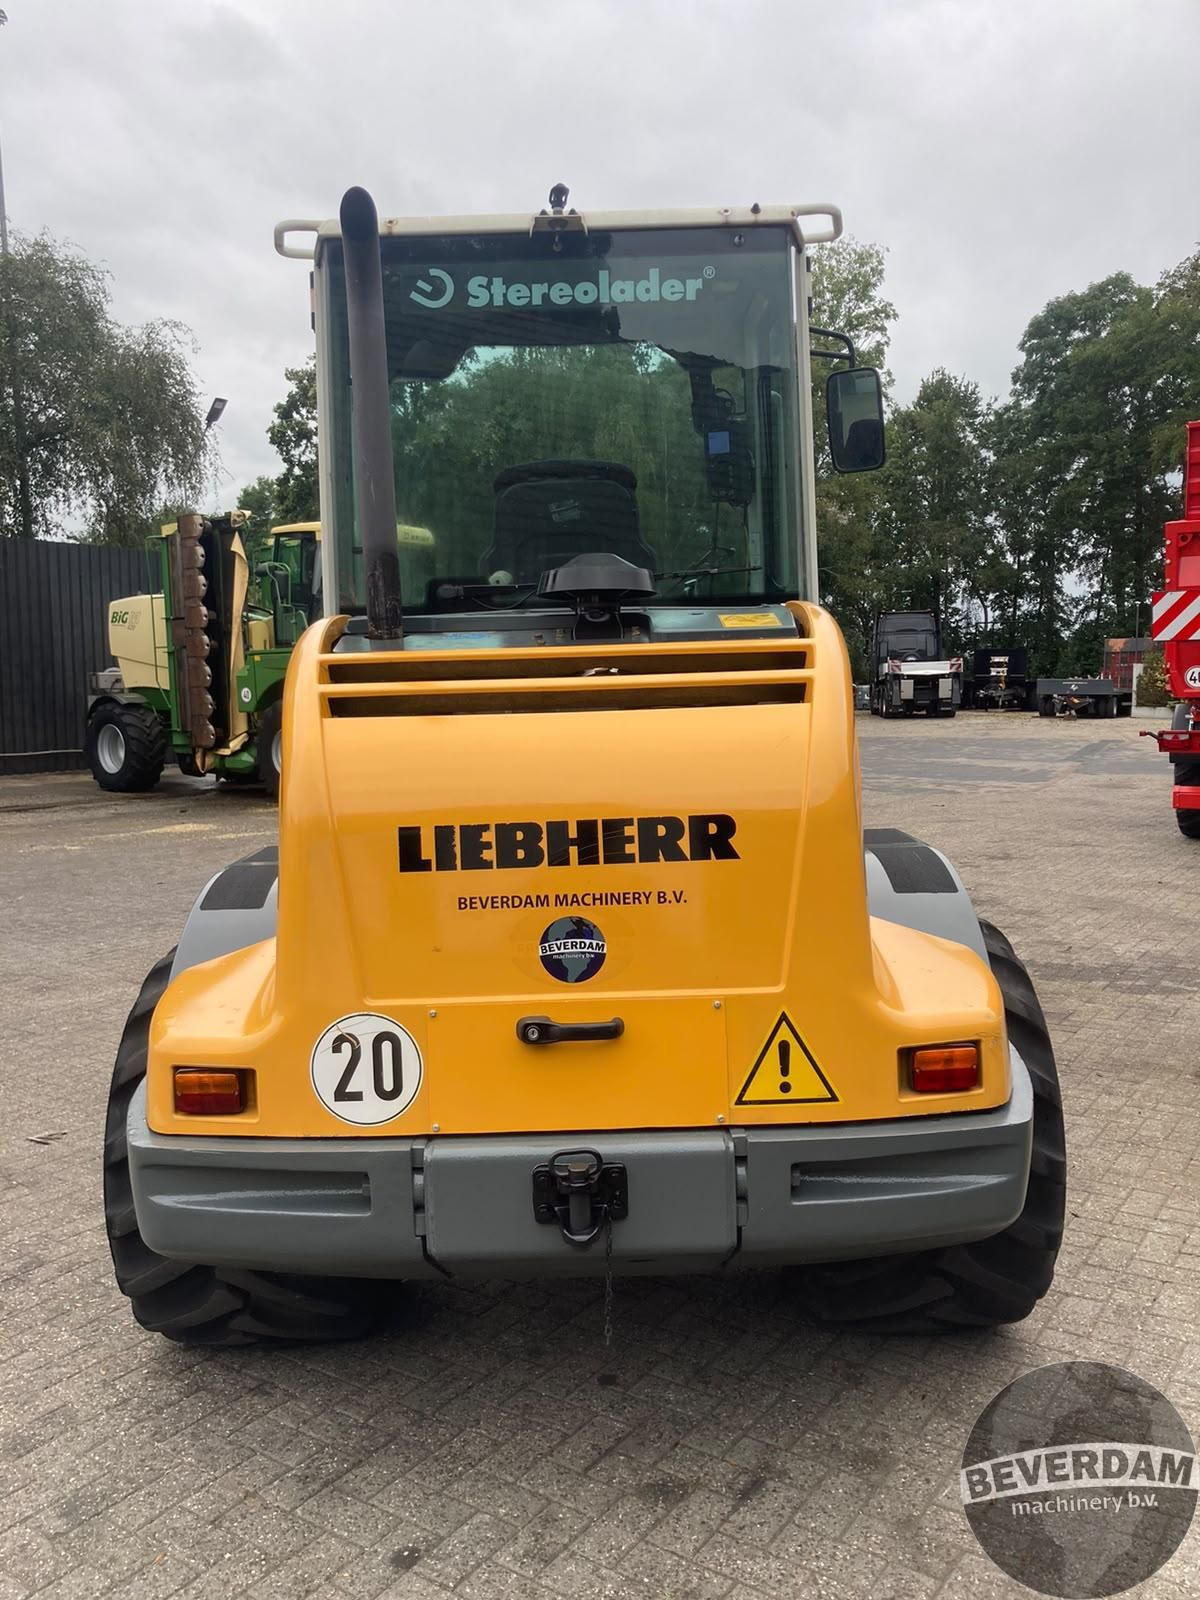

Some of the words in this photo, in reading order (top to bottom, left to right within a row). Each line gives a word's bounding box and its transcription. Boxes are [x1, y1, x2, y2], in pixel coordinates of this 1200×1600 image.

[398, 813, 741, 873] LIEBHERR
[457, 894, 550, 910] BEVERDAM
[554, 891, 652, 907] MACHINERY
[657, 890, 688, 904] B.V.
[540, 941, 605, 954] BEVERDAM
[331, 1030, 403, 1102] 20
